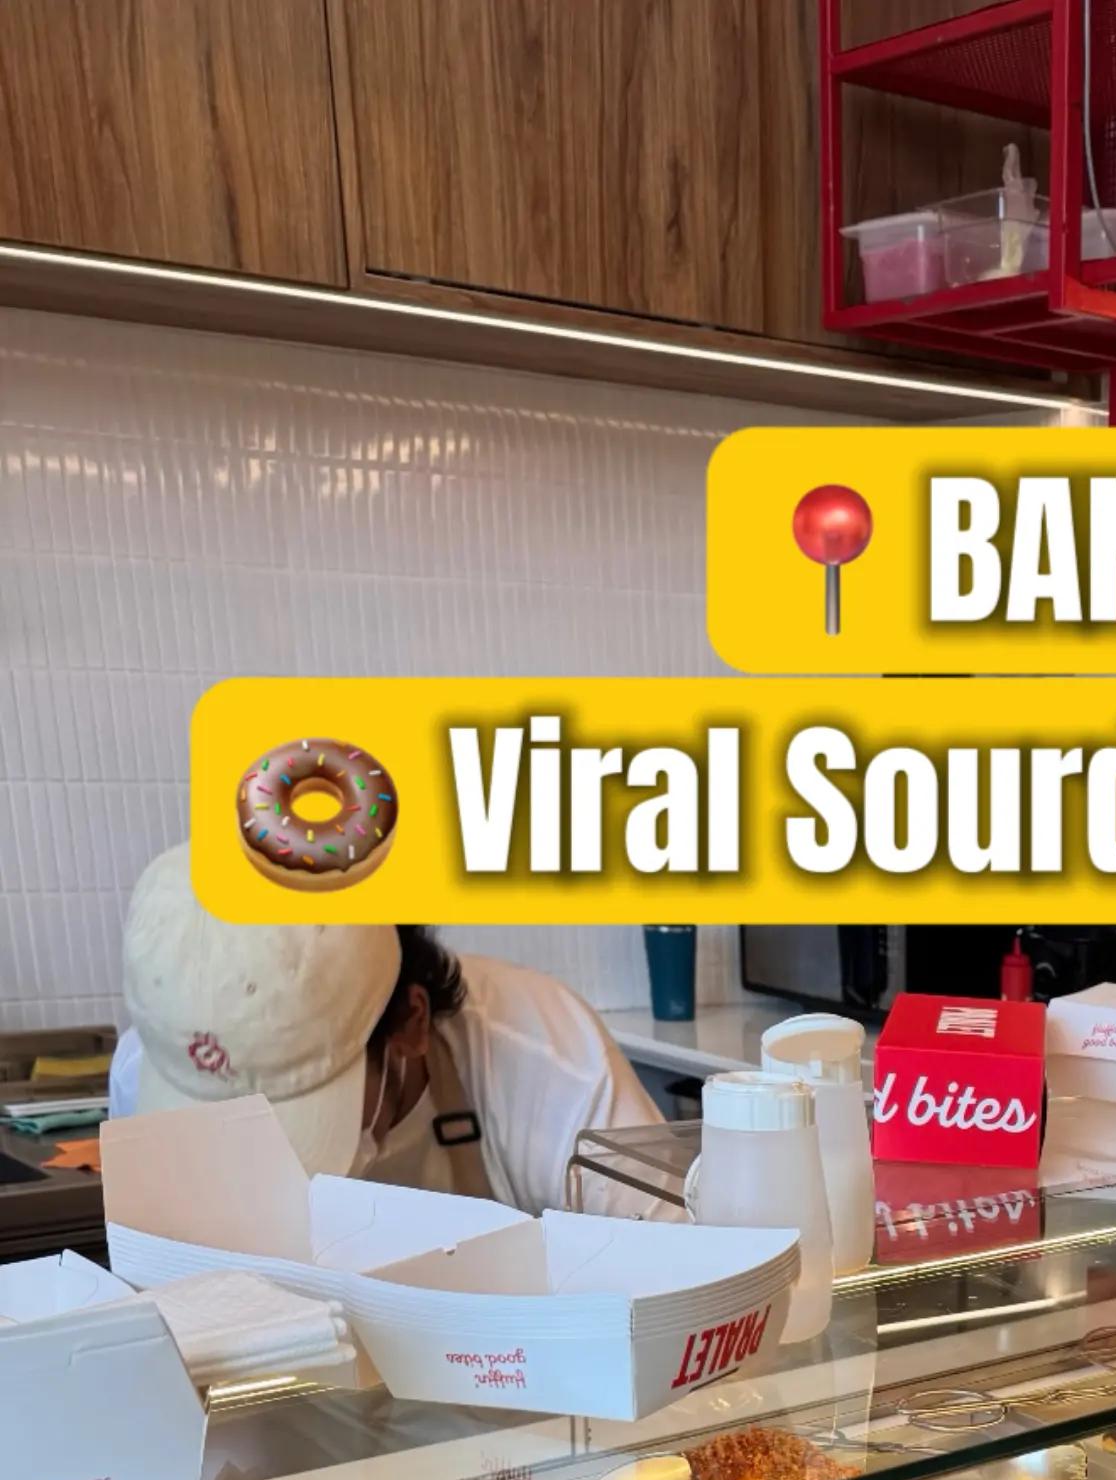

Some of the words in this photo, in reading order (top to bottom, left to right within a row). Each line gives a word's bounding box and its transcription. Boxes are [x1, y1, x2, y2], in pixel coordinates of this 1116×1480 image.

[907, 1082, 1037, 1134] bites
[484, 1348, 526, 1369] good
[671, 1304, 772, 1391] PRALET
